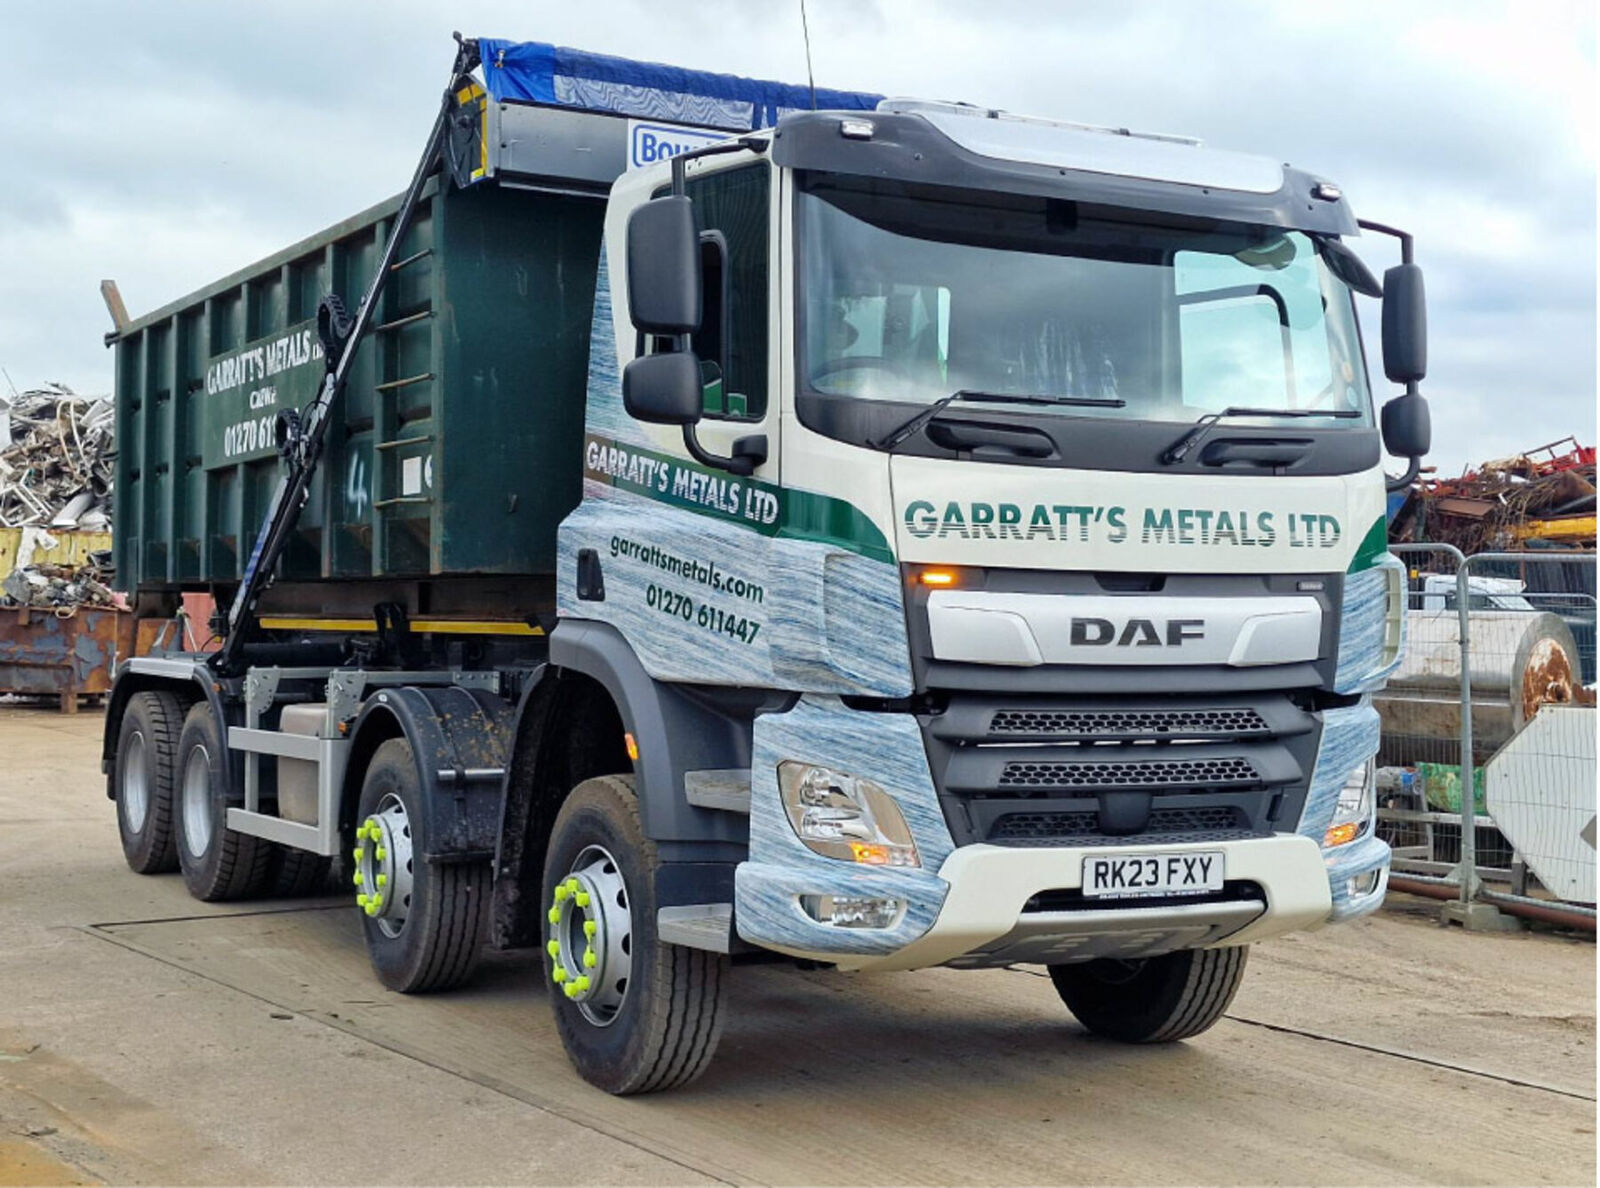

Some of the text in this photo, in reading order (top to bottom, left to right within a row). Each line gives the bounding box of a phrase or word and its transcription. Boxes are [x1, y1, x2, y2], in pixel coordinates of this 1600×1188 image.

[207, 346, 265, 395] GARRATT'S
[266, 329, 311, 376] METALS
[224, 419, 257, 457] 01270
[586, 441, 779, 524] GARRATT'S METALS LTD
[904, 500, 1341, 548] GARRATT'S METALS LTD
[610, 535, 764, 603] garrattsmetals.com
[646, 584, 760, 644] 01270 611447
[1070, 617, 1205, 646] DAF
[1094, 857, 1212, 889] RK23 FXY
